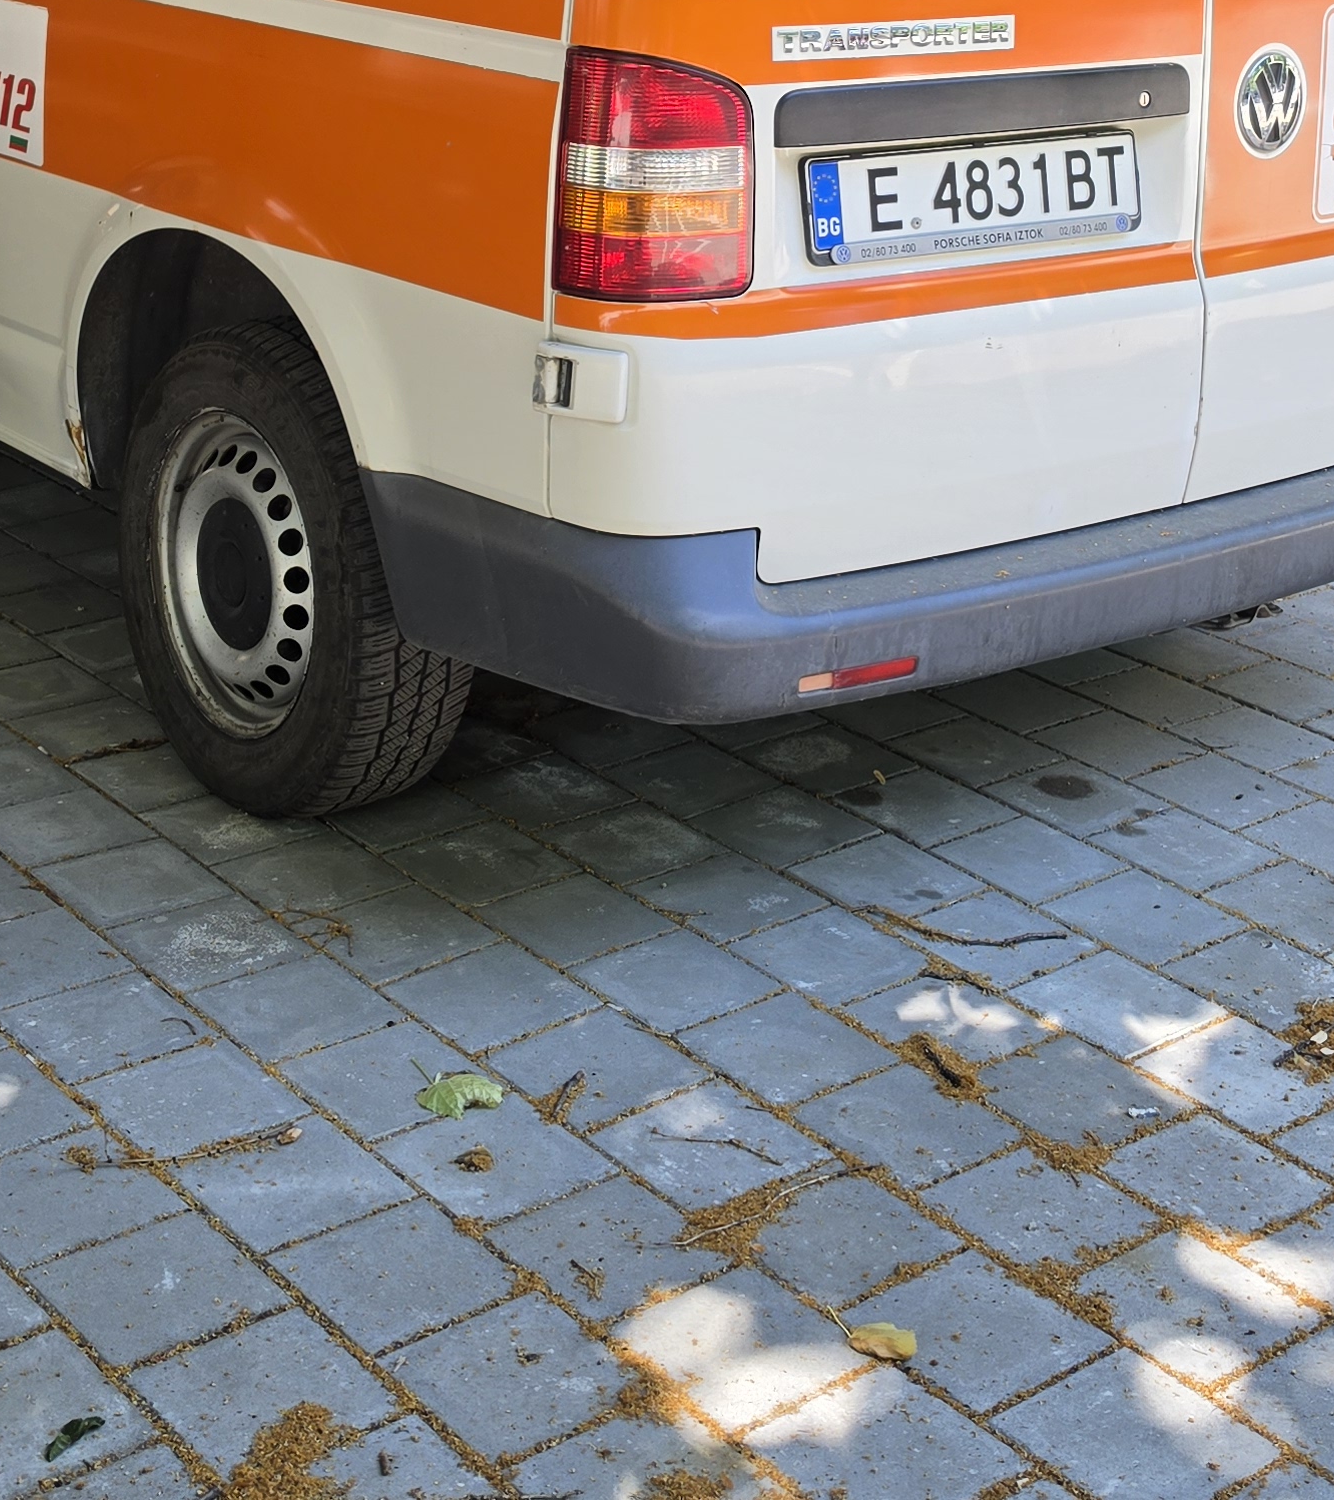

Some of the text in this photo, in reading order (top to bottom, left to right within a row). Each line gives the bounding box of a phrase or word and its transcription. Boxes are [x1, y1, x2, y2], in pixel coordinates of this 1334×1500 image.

[775, 18, 1011, 54] TRANSPORTER
[817, 217, 842, 238] BG
[933, 228, 1045, 249] PORSCHE SOFIA IZTOK
